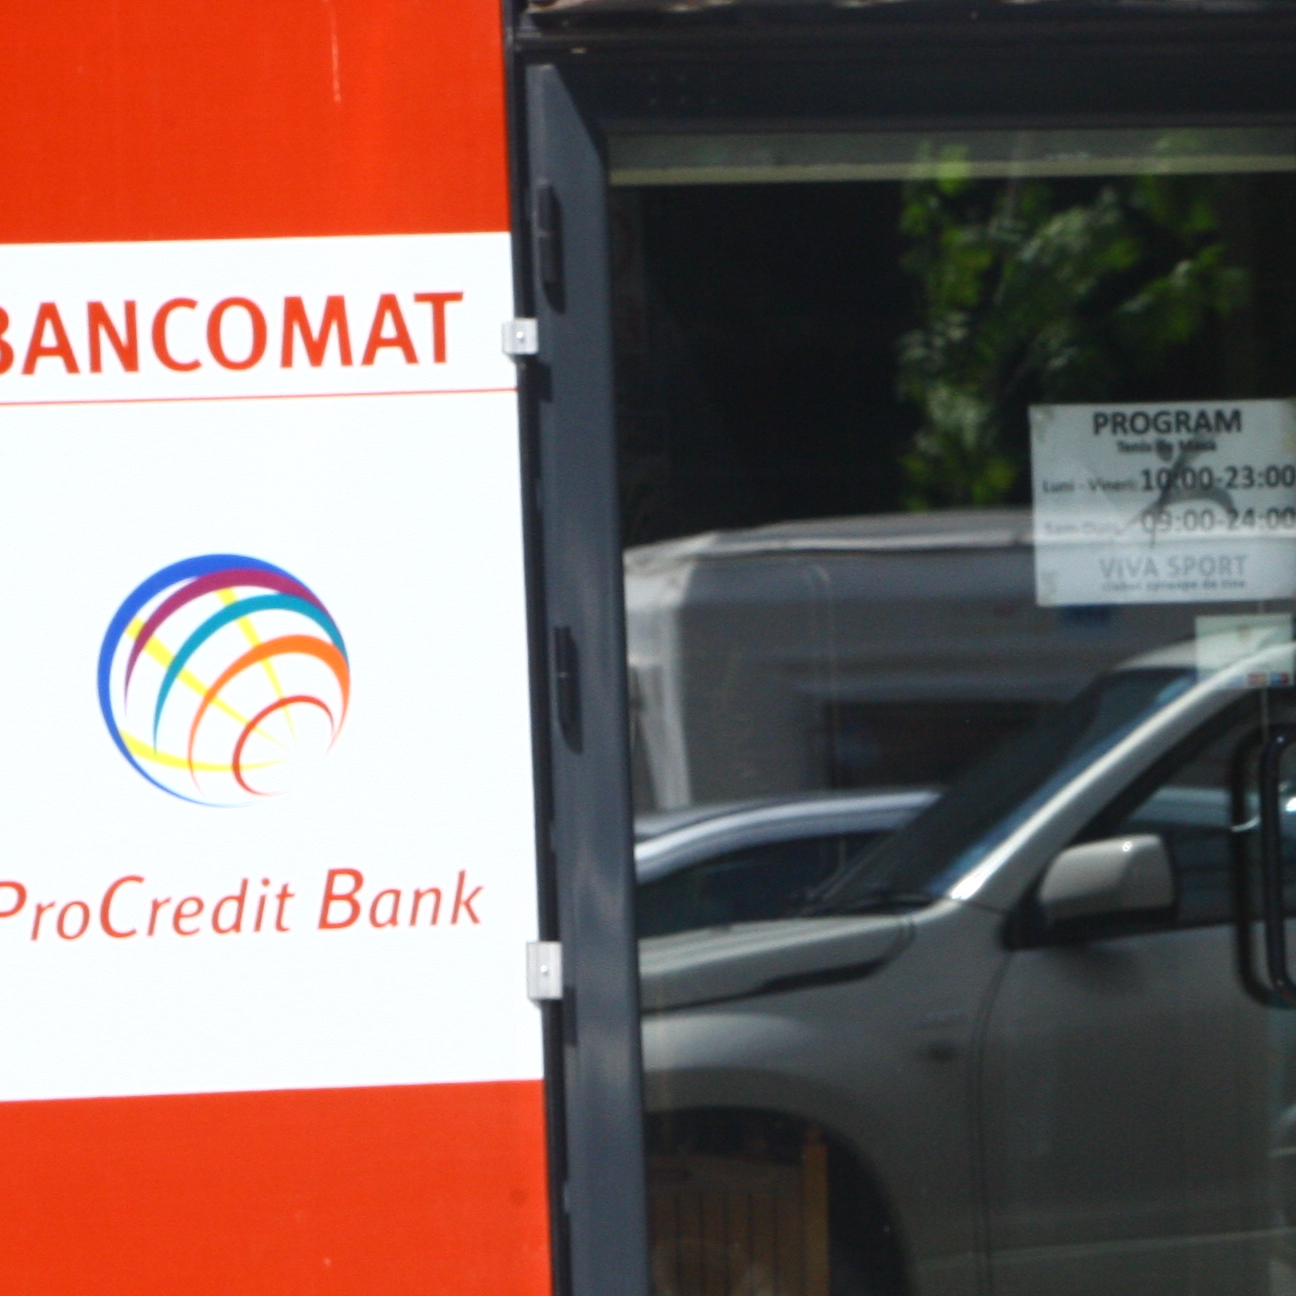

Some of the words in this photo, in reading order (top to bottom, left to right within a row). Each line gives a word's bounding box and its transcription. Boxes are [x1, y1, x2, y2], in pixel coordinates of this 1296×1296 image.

[1093, 409, 1242, 435] PROGRAM
[1100, 558, 1160, 578] VIVA
[1167, 554, 1248, 577] SPORT
[317, 867, 484, 931] Bank
